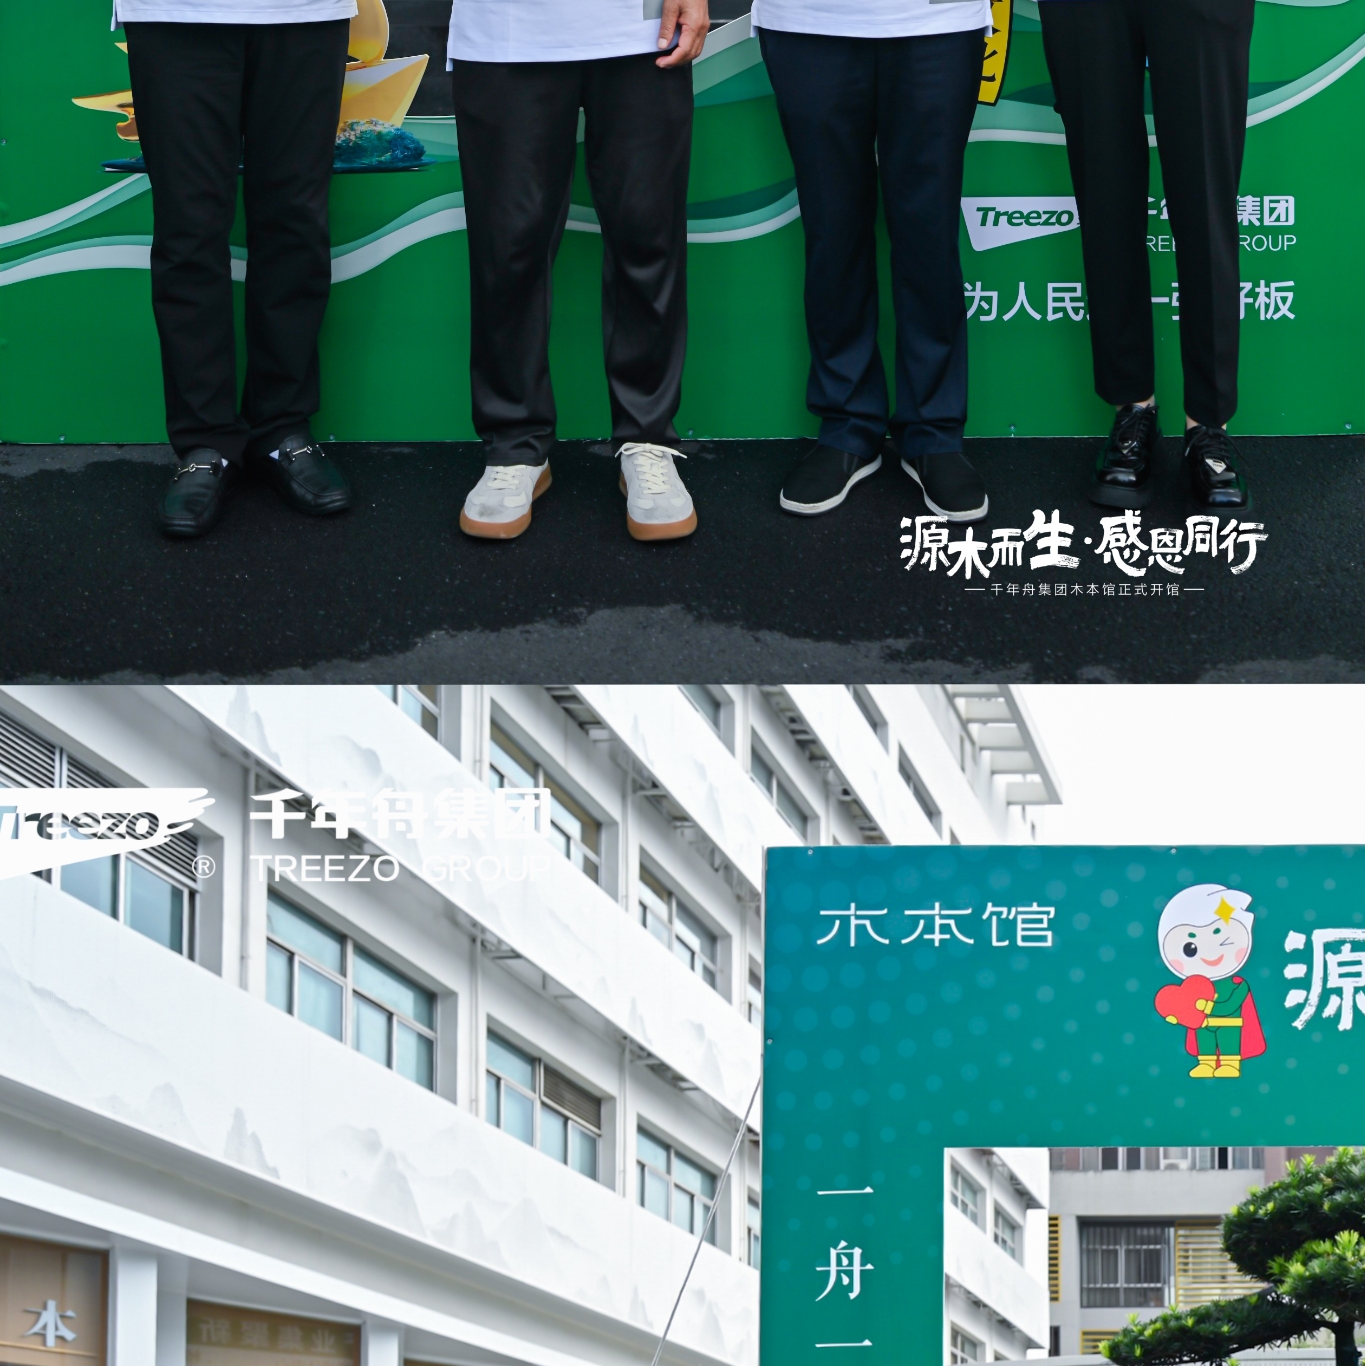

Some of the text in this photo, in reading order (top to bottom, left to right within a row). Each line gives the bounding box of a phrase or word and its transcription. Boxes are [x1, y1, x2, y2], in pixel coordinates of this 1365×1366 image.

[976, 206, 1075, 228] Treezo
[1239, 235, 1297, 252] ROUP
[816, 901, 1056, 948] 木本馆
[22, 1299, 77, 1348] 本
